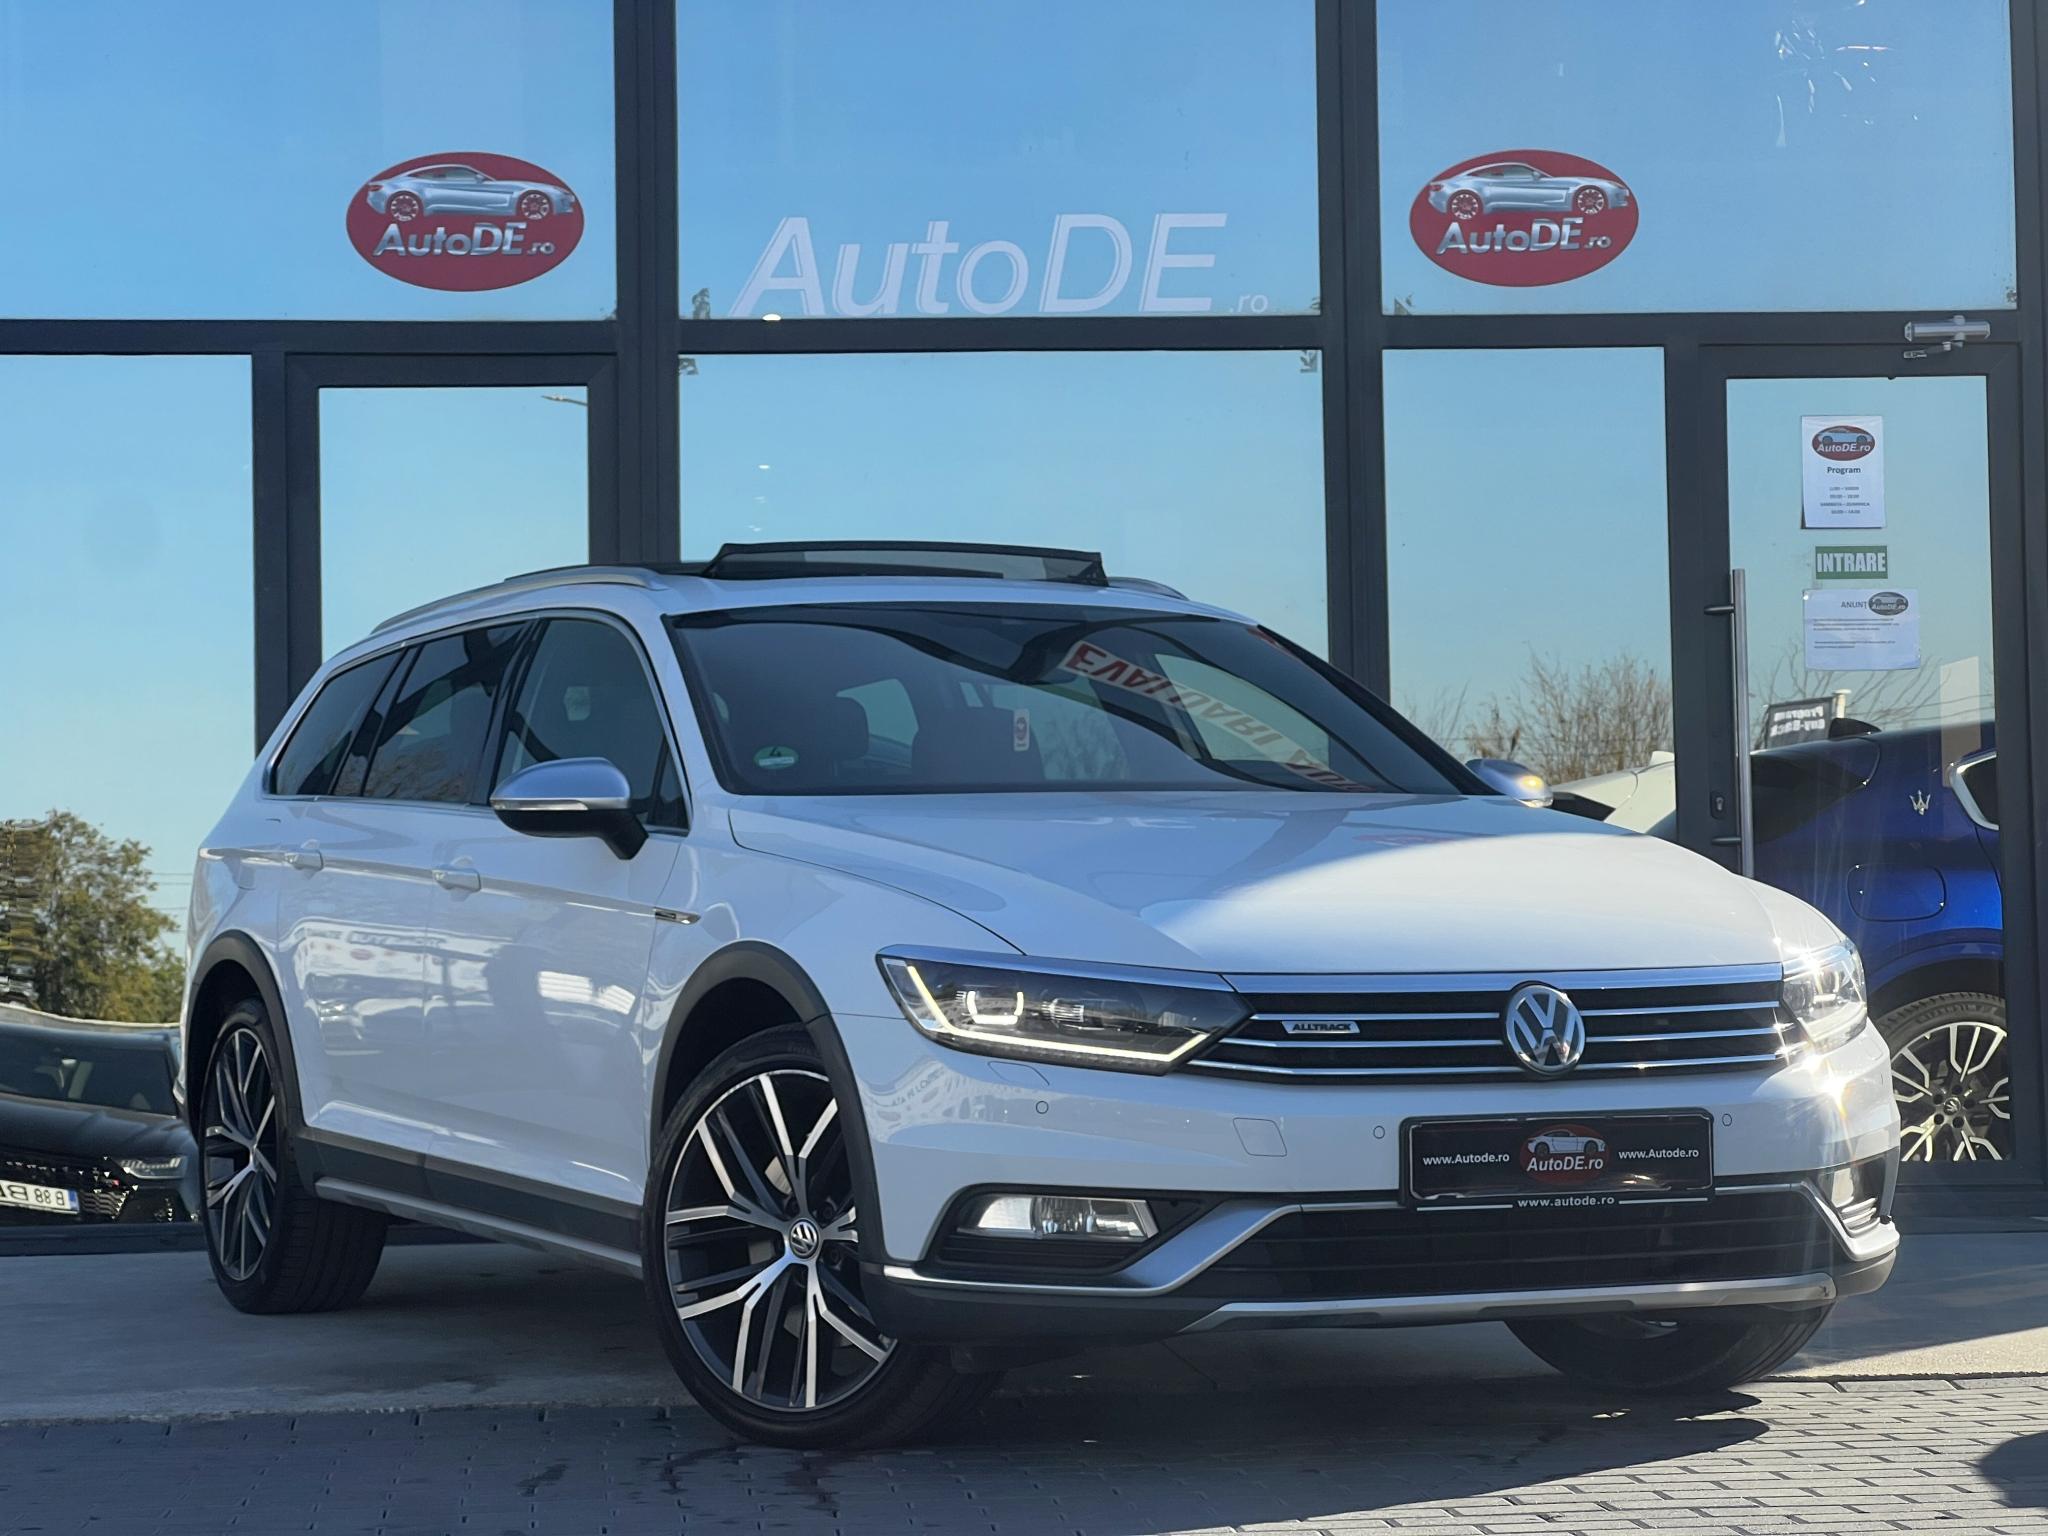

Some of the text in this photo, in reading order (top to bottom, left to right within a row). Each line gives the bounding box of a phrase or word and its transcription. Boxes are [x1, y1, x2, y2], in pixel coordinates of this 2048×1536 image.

[1826, 466, 1861, 475] Program
[1816, 552, 1887, 573] INTRARE
[1292, 1022, 1351, 1032] ALLTRACK
[1422, 1147, 1700, 1172] www.Autode.ro AutoDE.ro www.Autode.ro
[1517, 1195, 1616, 1208] www.autode.ro
